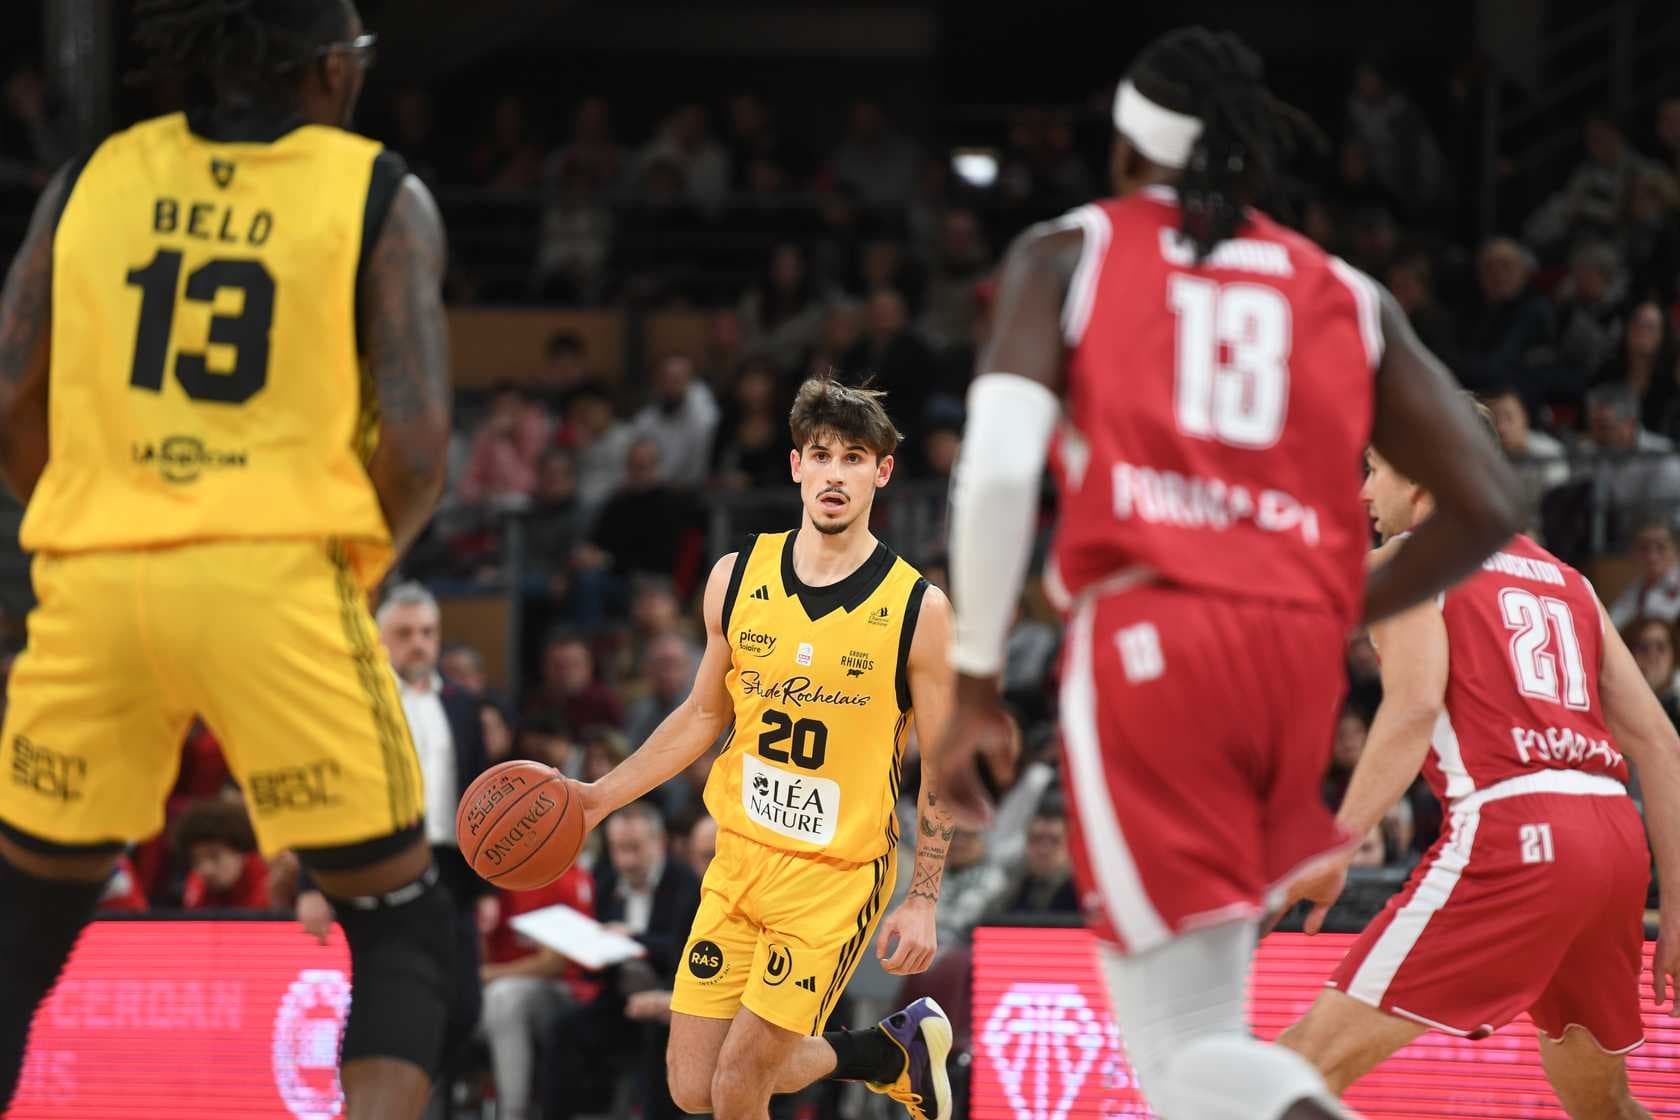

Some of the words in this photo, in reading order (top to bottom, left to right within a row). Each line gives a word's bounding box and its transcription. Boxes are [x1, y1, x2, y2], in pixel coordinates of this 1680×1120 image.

[153, 197, 273, 247] BELO
[126, 246, 278, 406] 13
[1165, 271, 1294, 451] 13
[739, 629, 777, 650] picoty
[840, 655, 875, 671] RHINOS
[1498, 586, 1591, 712] 21
[758, 708, 828, 770] 20
[470, 776, 527, 836] LEGACY
[750, 795, 824, 835] NATURE
[773, 779, 824, 815] LÉA
[485, 791, 556, 866] SPALDING
[1519, 822, 1555, 864] 21
[691, 952, 719, 968] RAS
